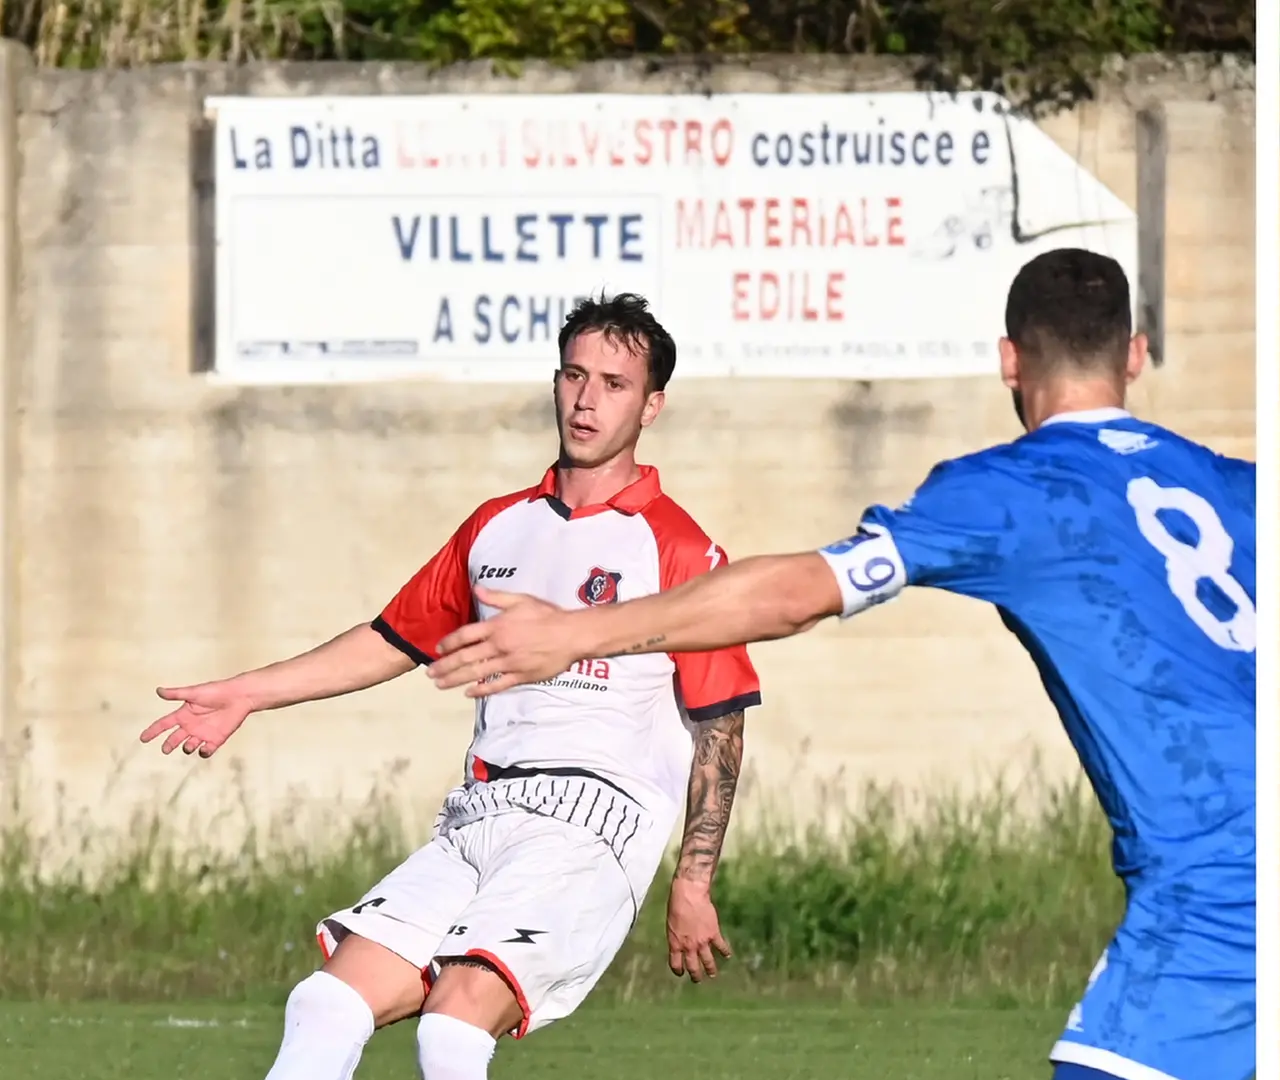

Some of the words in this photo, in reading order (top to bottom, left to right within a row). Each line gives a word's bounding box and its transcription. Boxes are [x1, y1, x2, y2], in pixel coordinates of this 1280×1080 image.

[229, 126, 273, 169] La
[290, 122, 380, 168] Ditta
[752, 118, 954, 167] costruisce
[971, 129, 990, 166] e
[392, 213, 644, 262] VILLETTE
[674, 197, 906, 248] MATERIALE
[432, 295, 455, 343] A
[472, 294, 586, 344] SCHI
[731, 271, 846, 321] EDILE
[478, 564, 518, 580] Zeus
[1126, 476, 1256, 653] 8
[536, 677, 608, 692] ssimiliano
